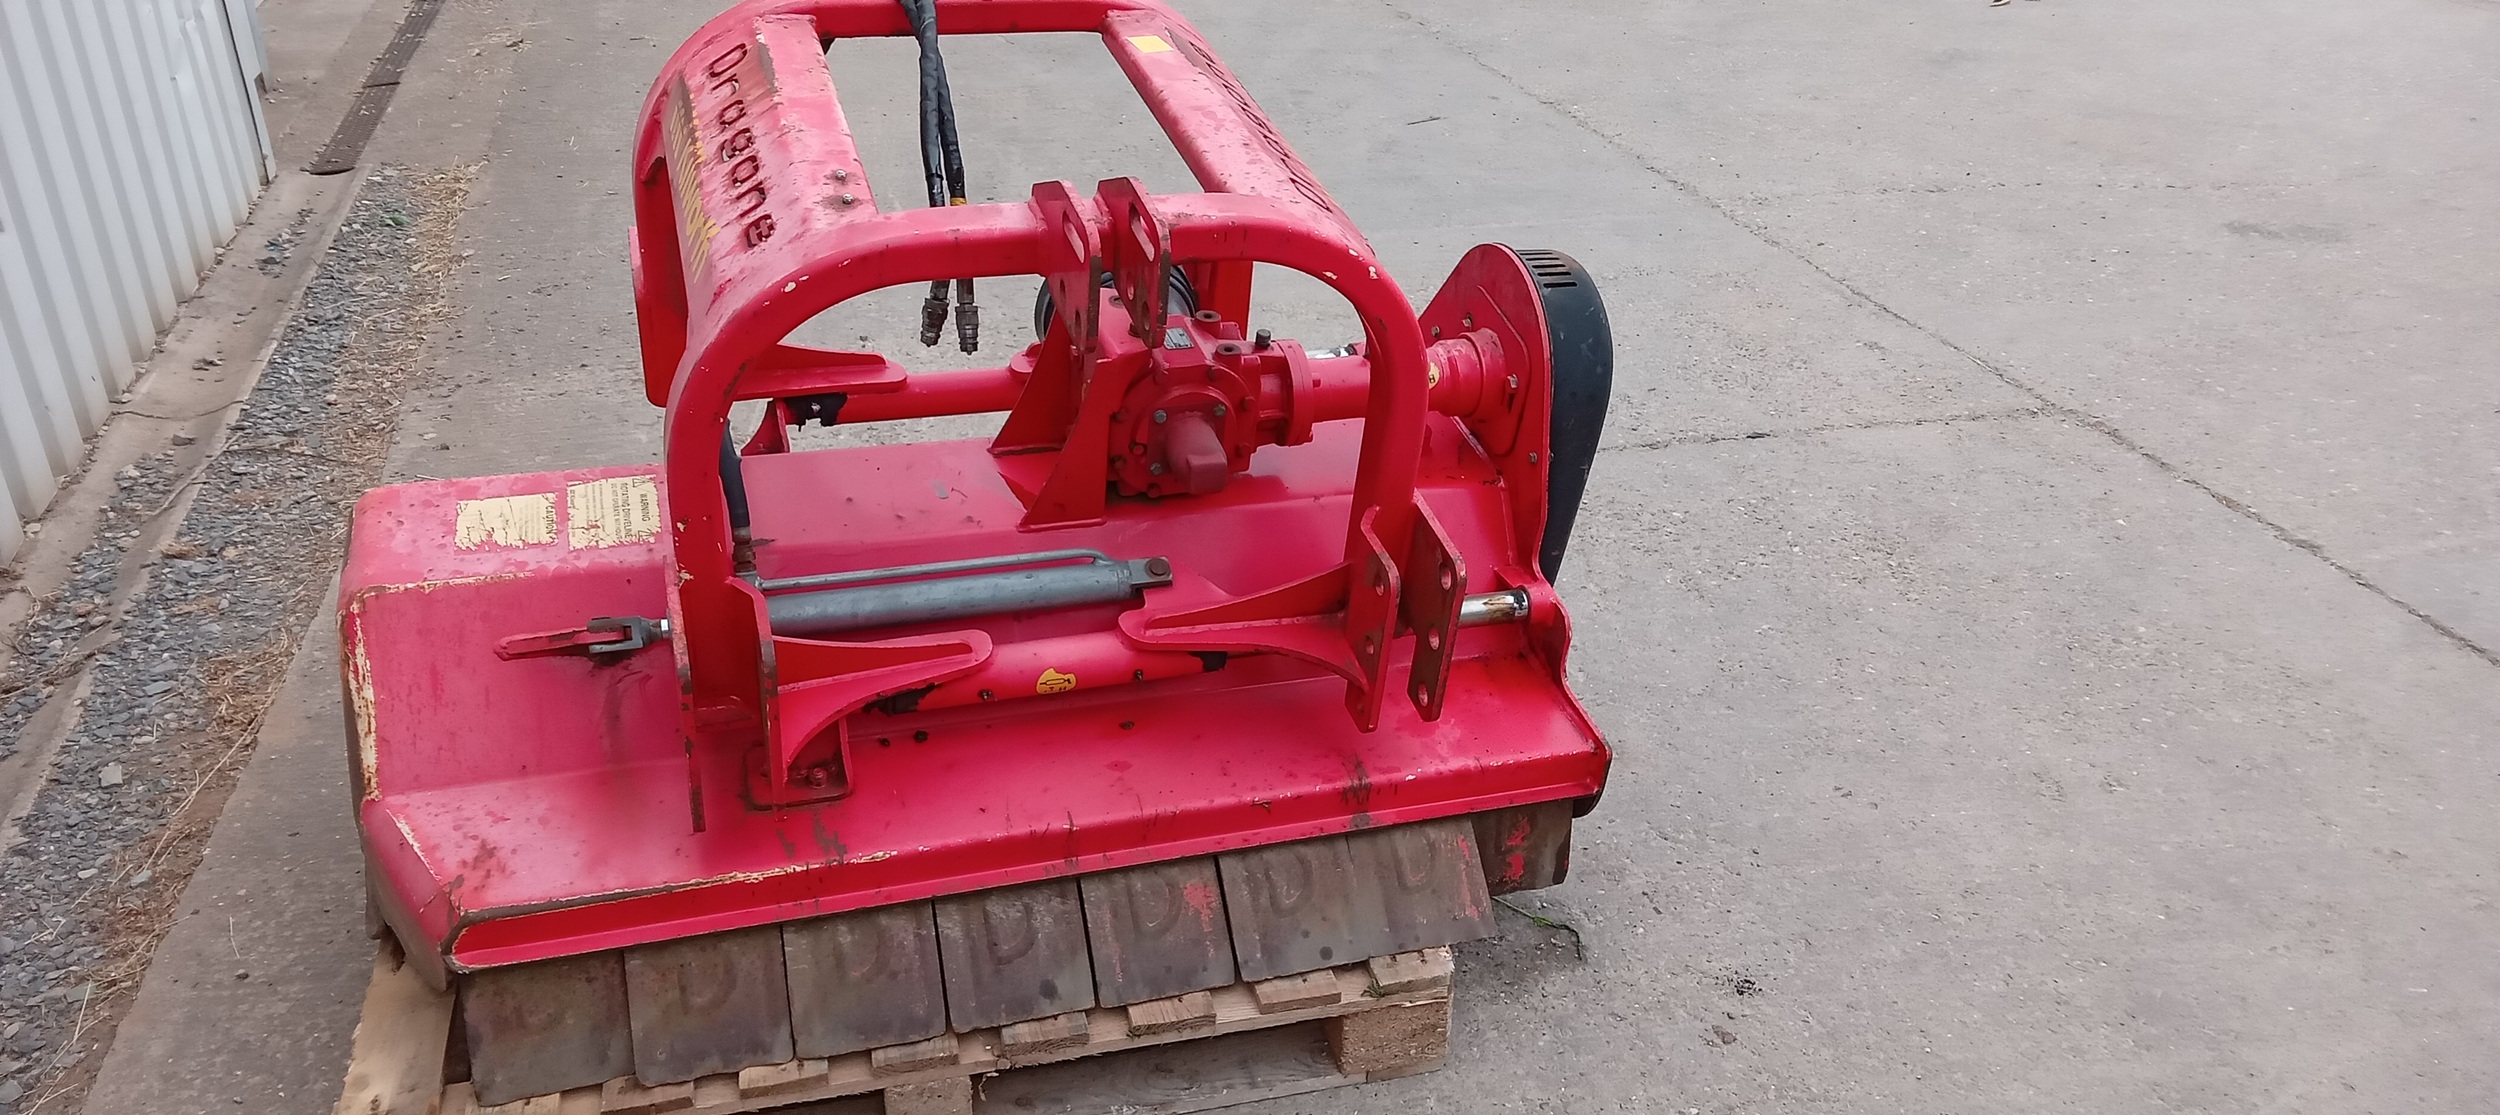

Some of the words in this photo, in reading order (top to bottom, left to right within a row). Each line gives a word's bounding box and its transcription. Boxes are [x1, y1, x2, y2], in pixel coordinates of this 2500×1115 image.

[707, 42, 778, 249] Dragone
[620, 482, 630, 508] ROTATING
[639, 492, 651, 522] WARNING
[545, 505, 555, 535] CAUTION
[622, 508, 633, 539] DRIVELINE
